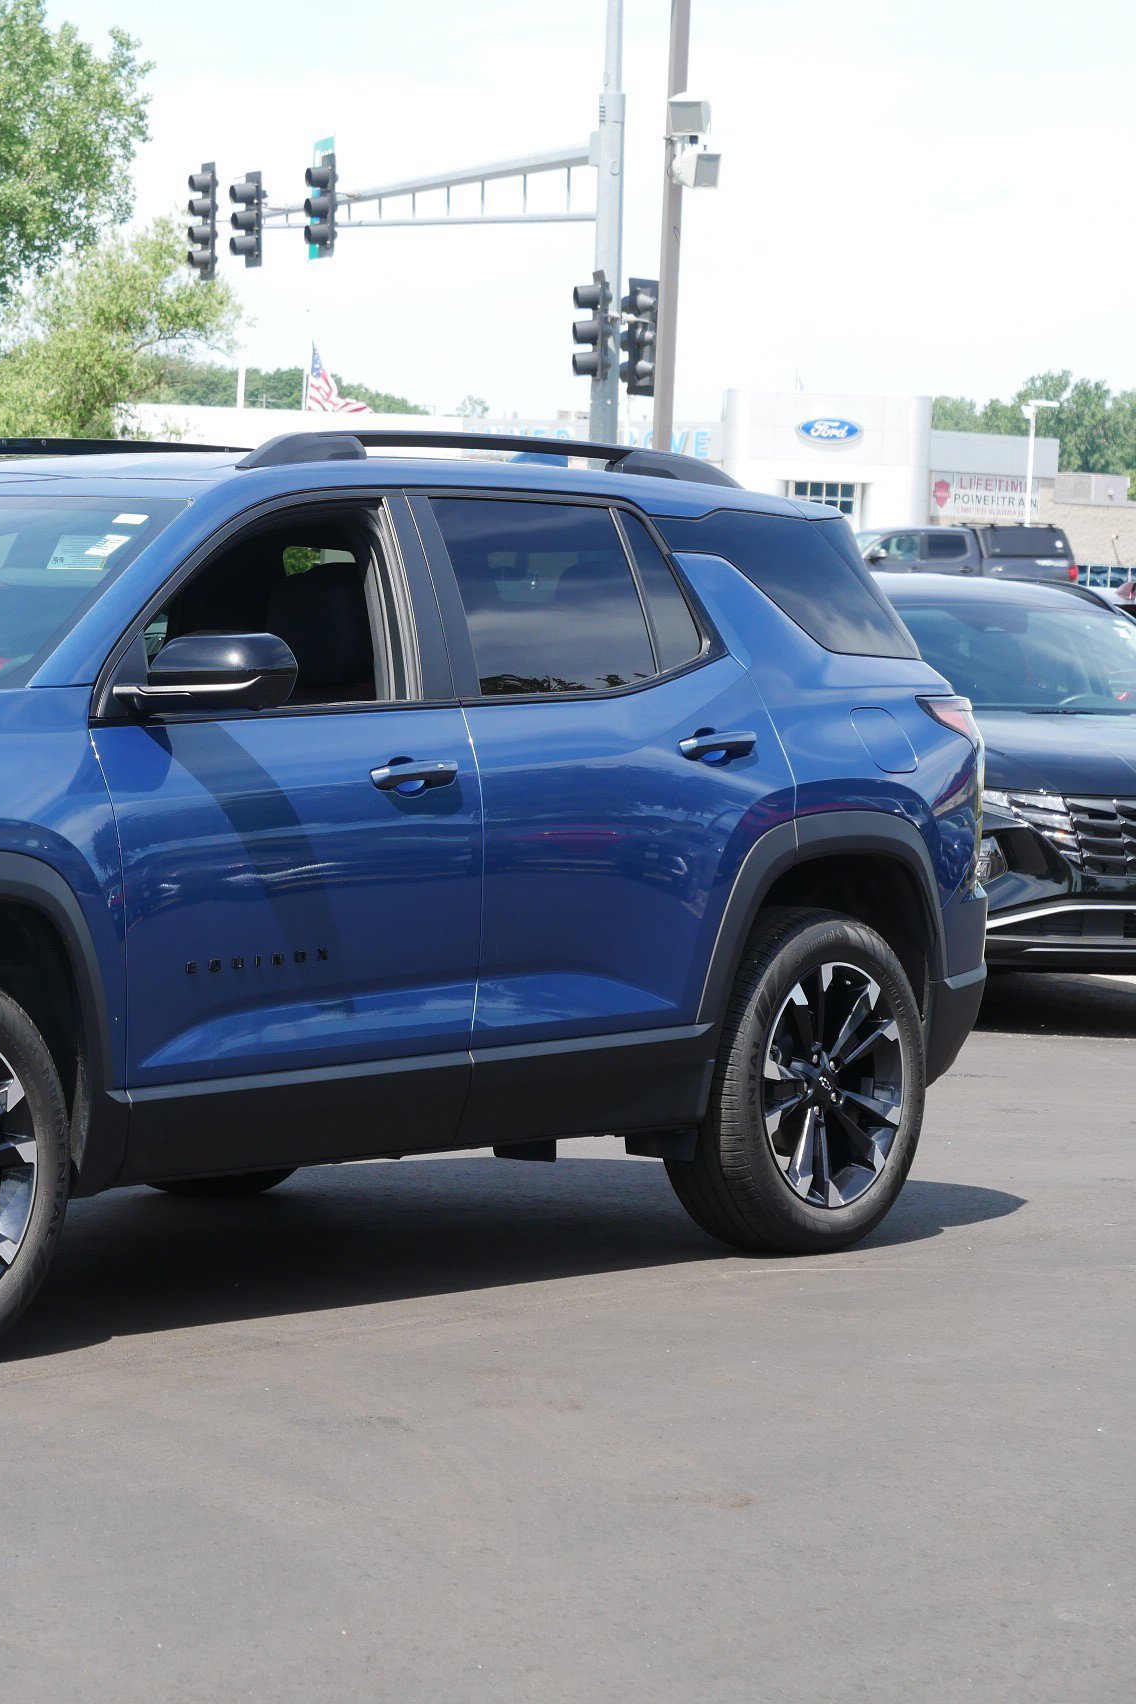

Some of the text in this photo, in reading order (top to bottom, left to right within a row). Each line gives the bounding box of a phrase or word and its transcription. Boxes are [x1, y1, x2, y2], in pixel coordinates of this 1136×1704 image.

[809, 420, 849, 438] Ford
[959, 476, 1029, 494] LIFETIM
[953, 493, 1037, 508] POWERTRAN
[185, 947, 329, 974] EQUINOX
